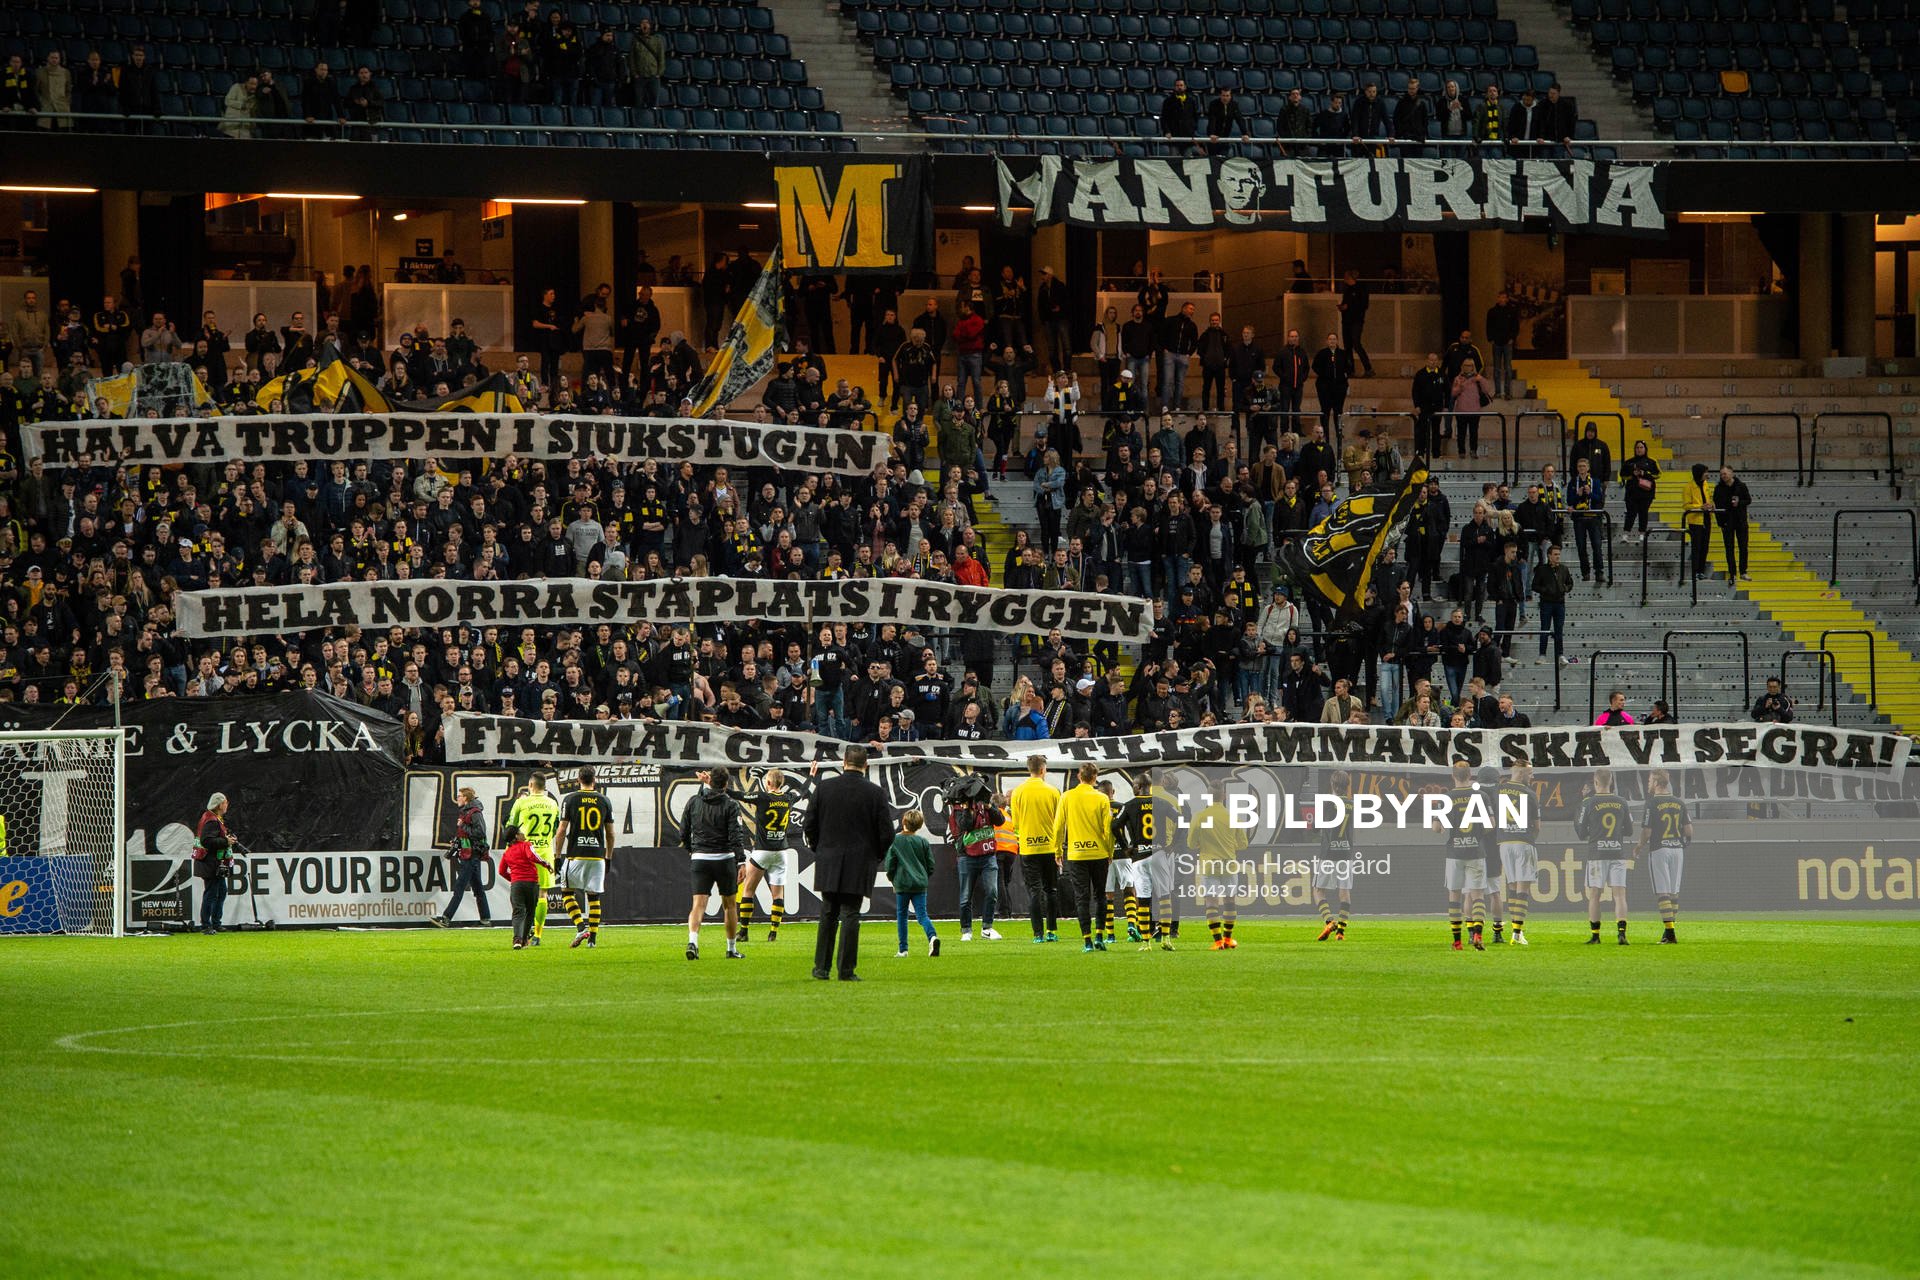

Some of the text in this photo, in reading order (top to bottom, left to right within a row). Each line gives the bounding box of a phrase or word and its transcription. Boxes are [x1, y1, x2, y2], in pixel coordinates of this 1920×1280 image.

[1273, 158, 1665, 230] TURINA
[774, 164, 902, 268] M
[41, 418, 876, 470] HALVA TRUPPEN I SJUKSTUGAN
[202, 588, 358, 632] HELA
[371, 584, 579, 623] NORRA
[879, 583, 902, 617] I
[911, 586, 1144, 636] RYGGEN
[166, 723, 198, 754] &
[216, 719, 382, 754] LYCKA
[1058, 727, 1483, 767] TILLSAMMANS
[1500, 731, 1610, 768] SKA
[1619, 728, 1681, 765] VI
[1693, 728, 1898, 772] SEGRA!
[527, 813, 553, 837] 23
[578, 806, 602, 831] 10
[765, 809, 790, 831] 24
[1141, 812, 1157, 839] 8
[1602, 812, 1617, 838] 9
[1660, 813, 1681, 839] 21
[577, 836, 599, 845] SVEA
[1026, 835, 1050, 845] SVEA
[1073, 841, 1099, 849] SVEA
[1453, 837, 1478, 845] SVEA
[1597, 840, 1621, 848] SVEA
[228, 858, 270, 895] BE
[276, 856, 371, 895] YOUR
[1797, 845, 1920, 903] nota
[289, 897, 437, 921] newwaveprofile.com
